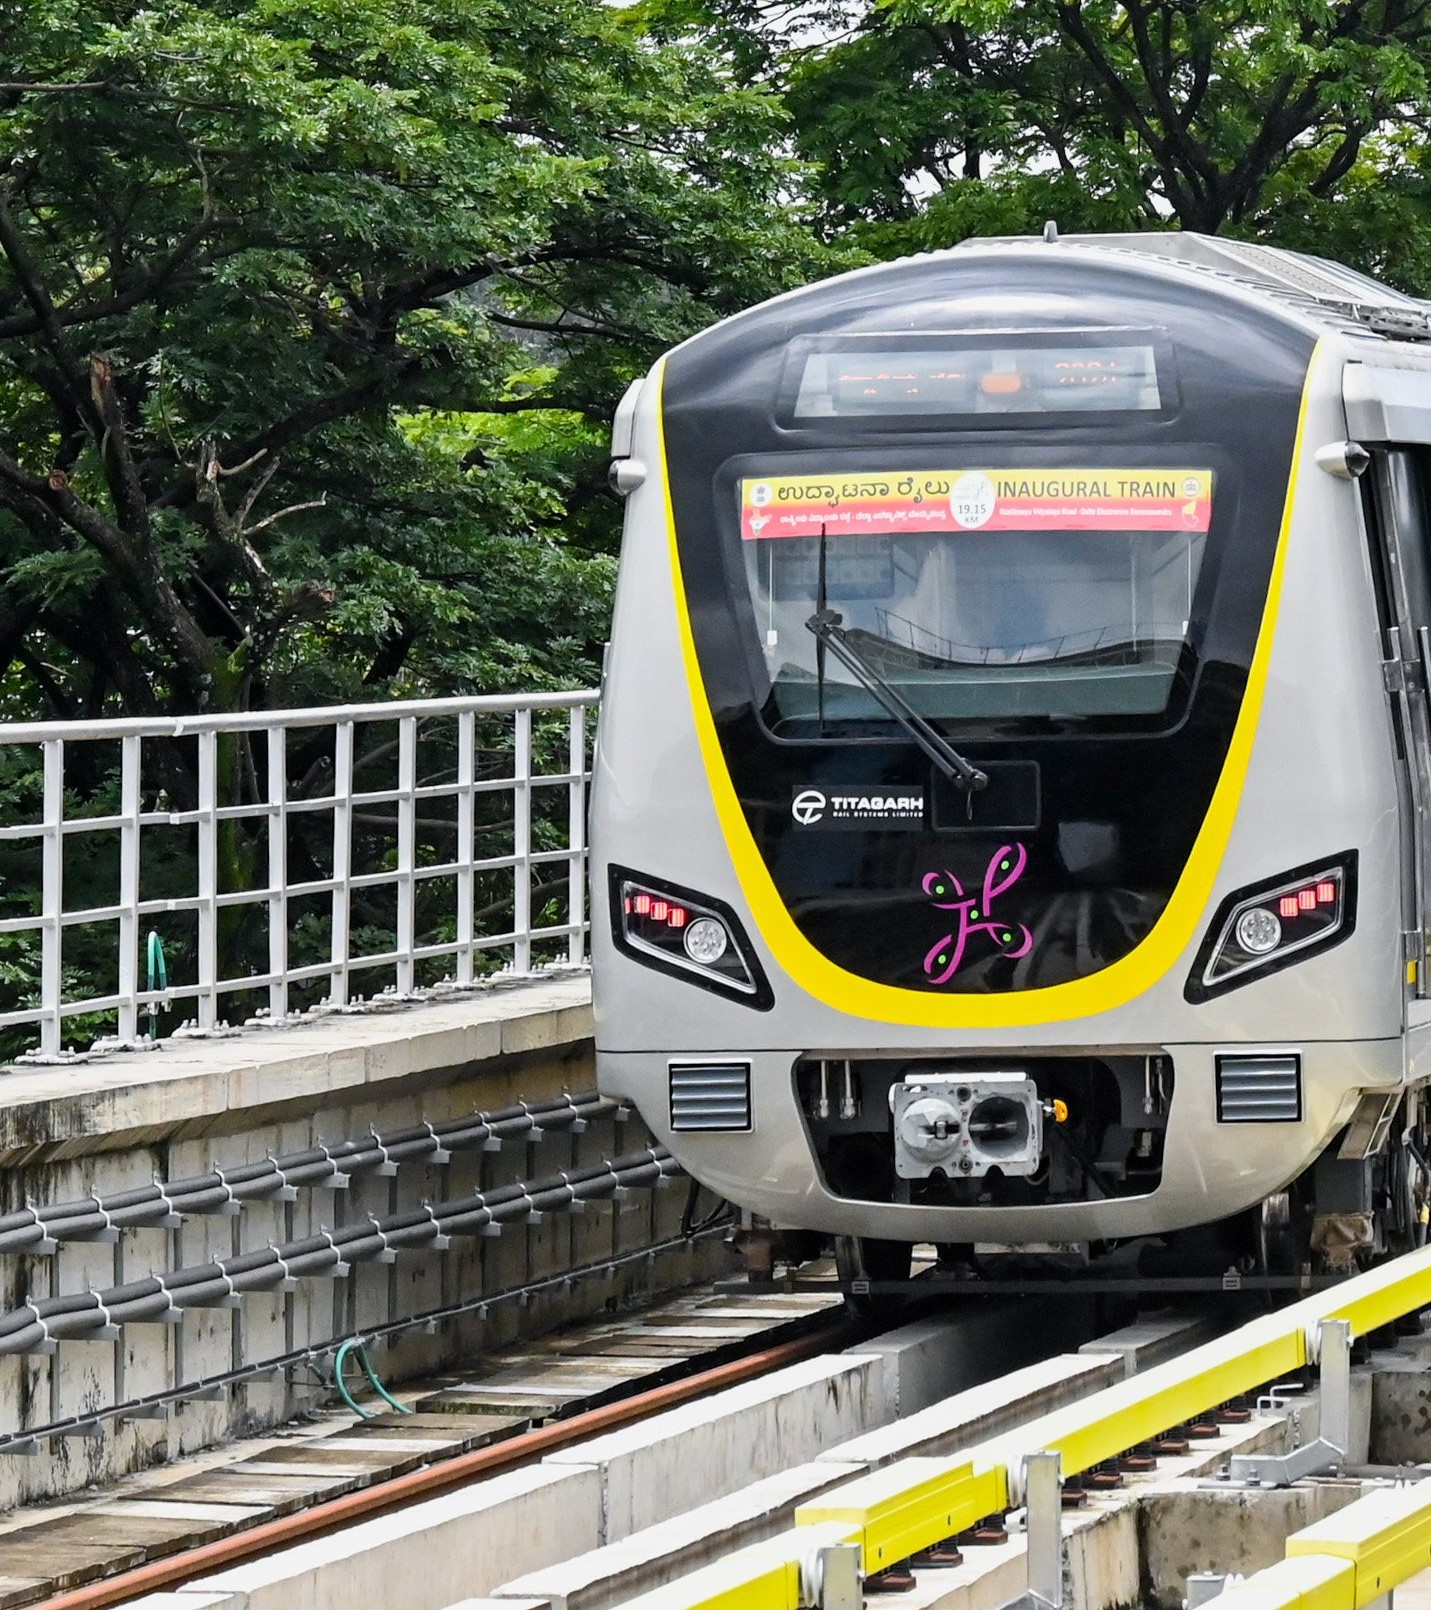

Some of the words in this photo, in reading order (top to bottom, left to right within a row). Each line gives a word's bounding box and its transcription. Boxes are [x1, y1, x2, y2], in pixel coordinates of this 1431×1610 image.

[897, 476, 950, 504] ರೈಲು
[997, 480, 1111, 498] INAUGURAL
[1117, 480, 1176, 498] TRAIN
[958, 504, 986, 514] 19.15
[831, 797, 924, 810] TITAGARH
